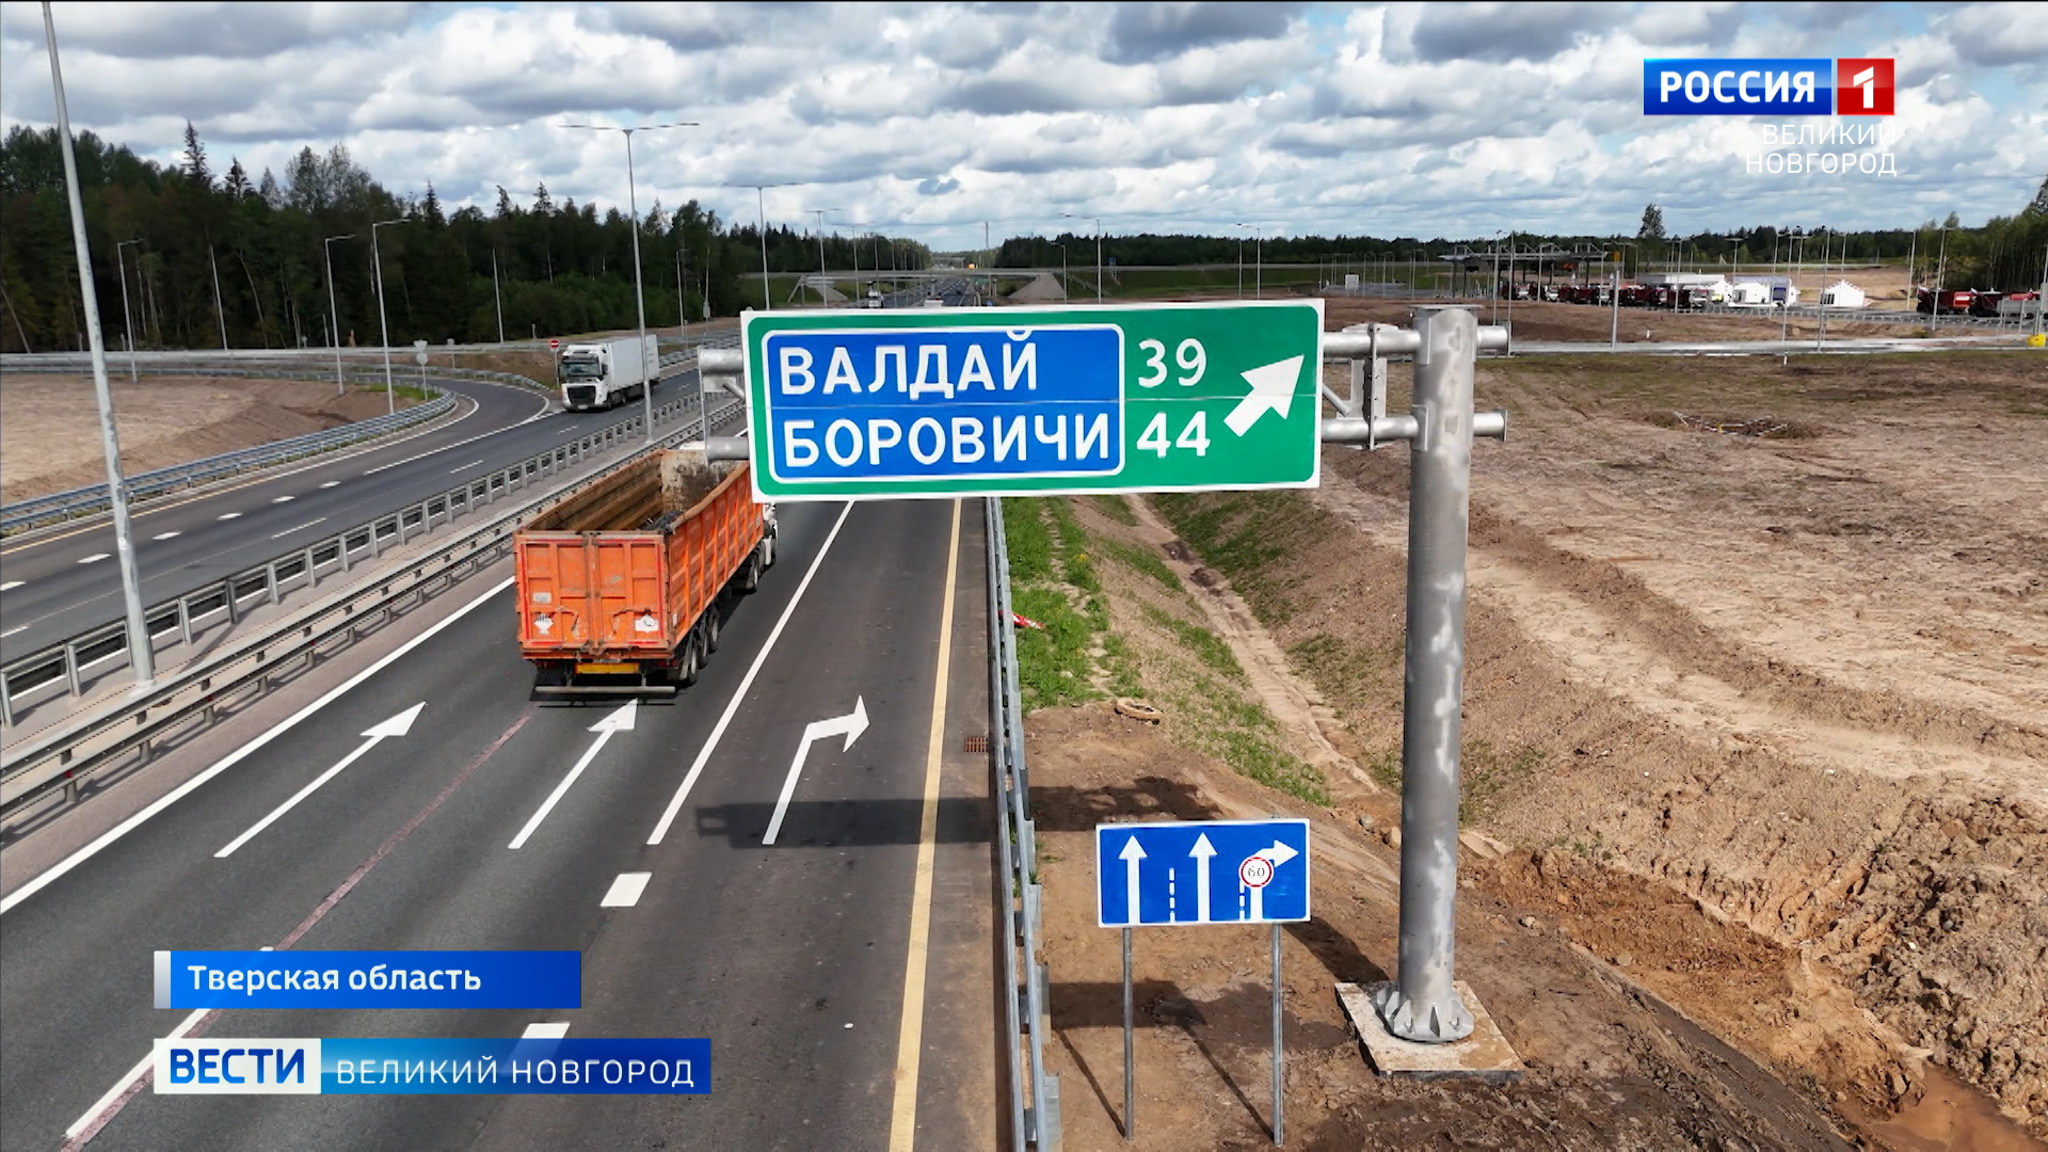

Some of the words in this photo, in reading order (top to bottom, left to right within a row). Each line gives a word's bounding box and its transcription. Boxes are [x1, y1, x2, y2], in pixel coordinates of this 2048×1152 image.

[778, 327, 1037, 400] ВАЛДАЙ
[1137, 338, 1207, 388] 39
[783, 413, 1110, 467] БОРОВИЧИ
[1136, 410, 1211, 458] 44
[1247, 865, 1265, 878] 60
